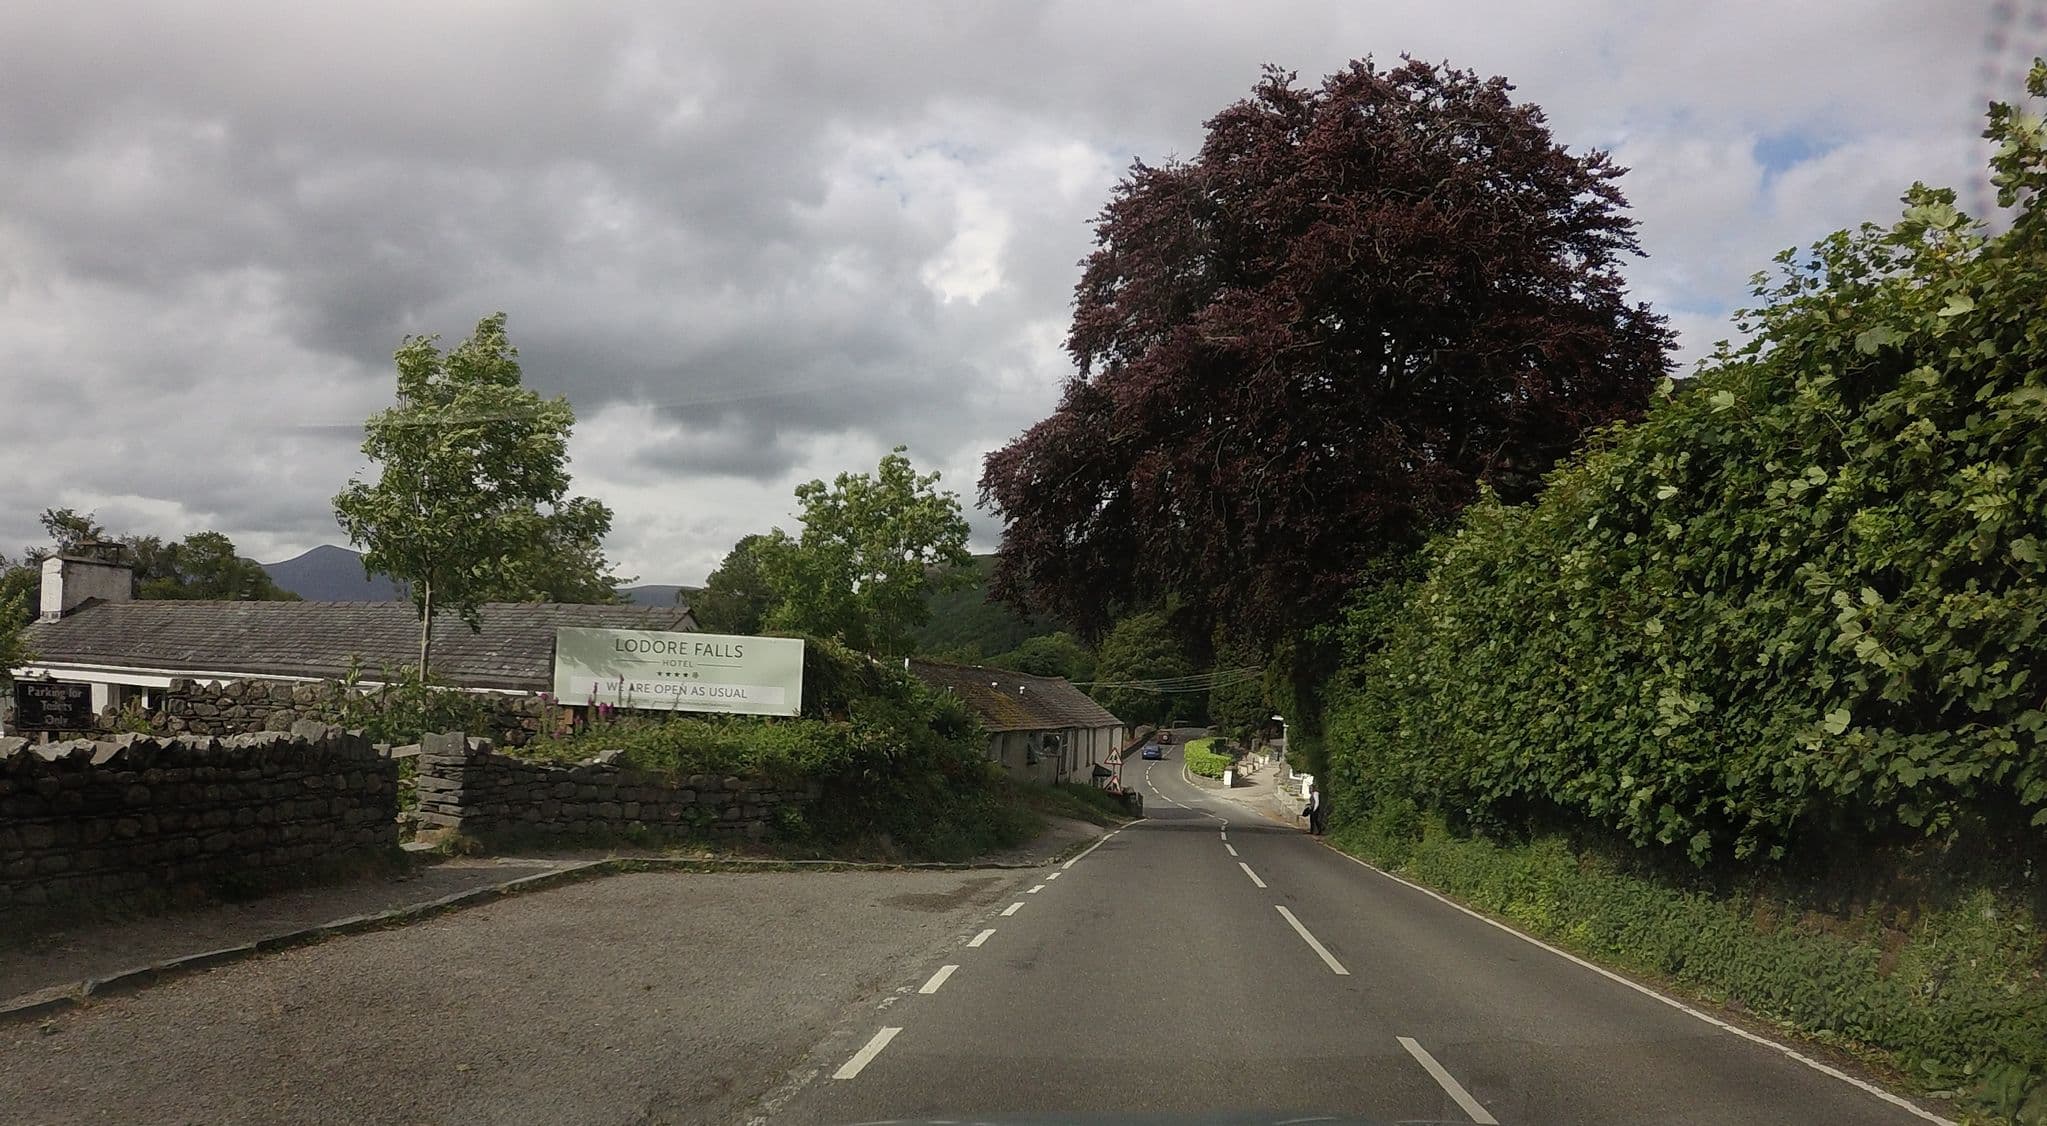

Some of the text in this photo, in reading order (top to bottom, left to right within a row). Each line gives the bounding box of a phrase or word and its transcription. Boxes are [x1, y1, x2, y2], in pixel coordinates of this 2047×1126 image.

[615, 638, 744, 658] LODORE FALLS
[662, 660, 693, 668] HOTEL
[28, 686, 83, 700] Parking for
[606, 681, 747, 699] WE ARE OPEN AS USUAL
